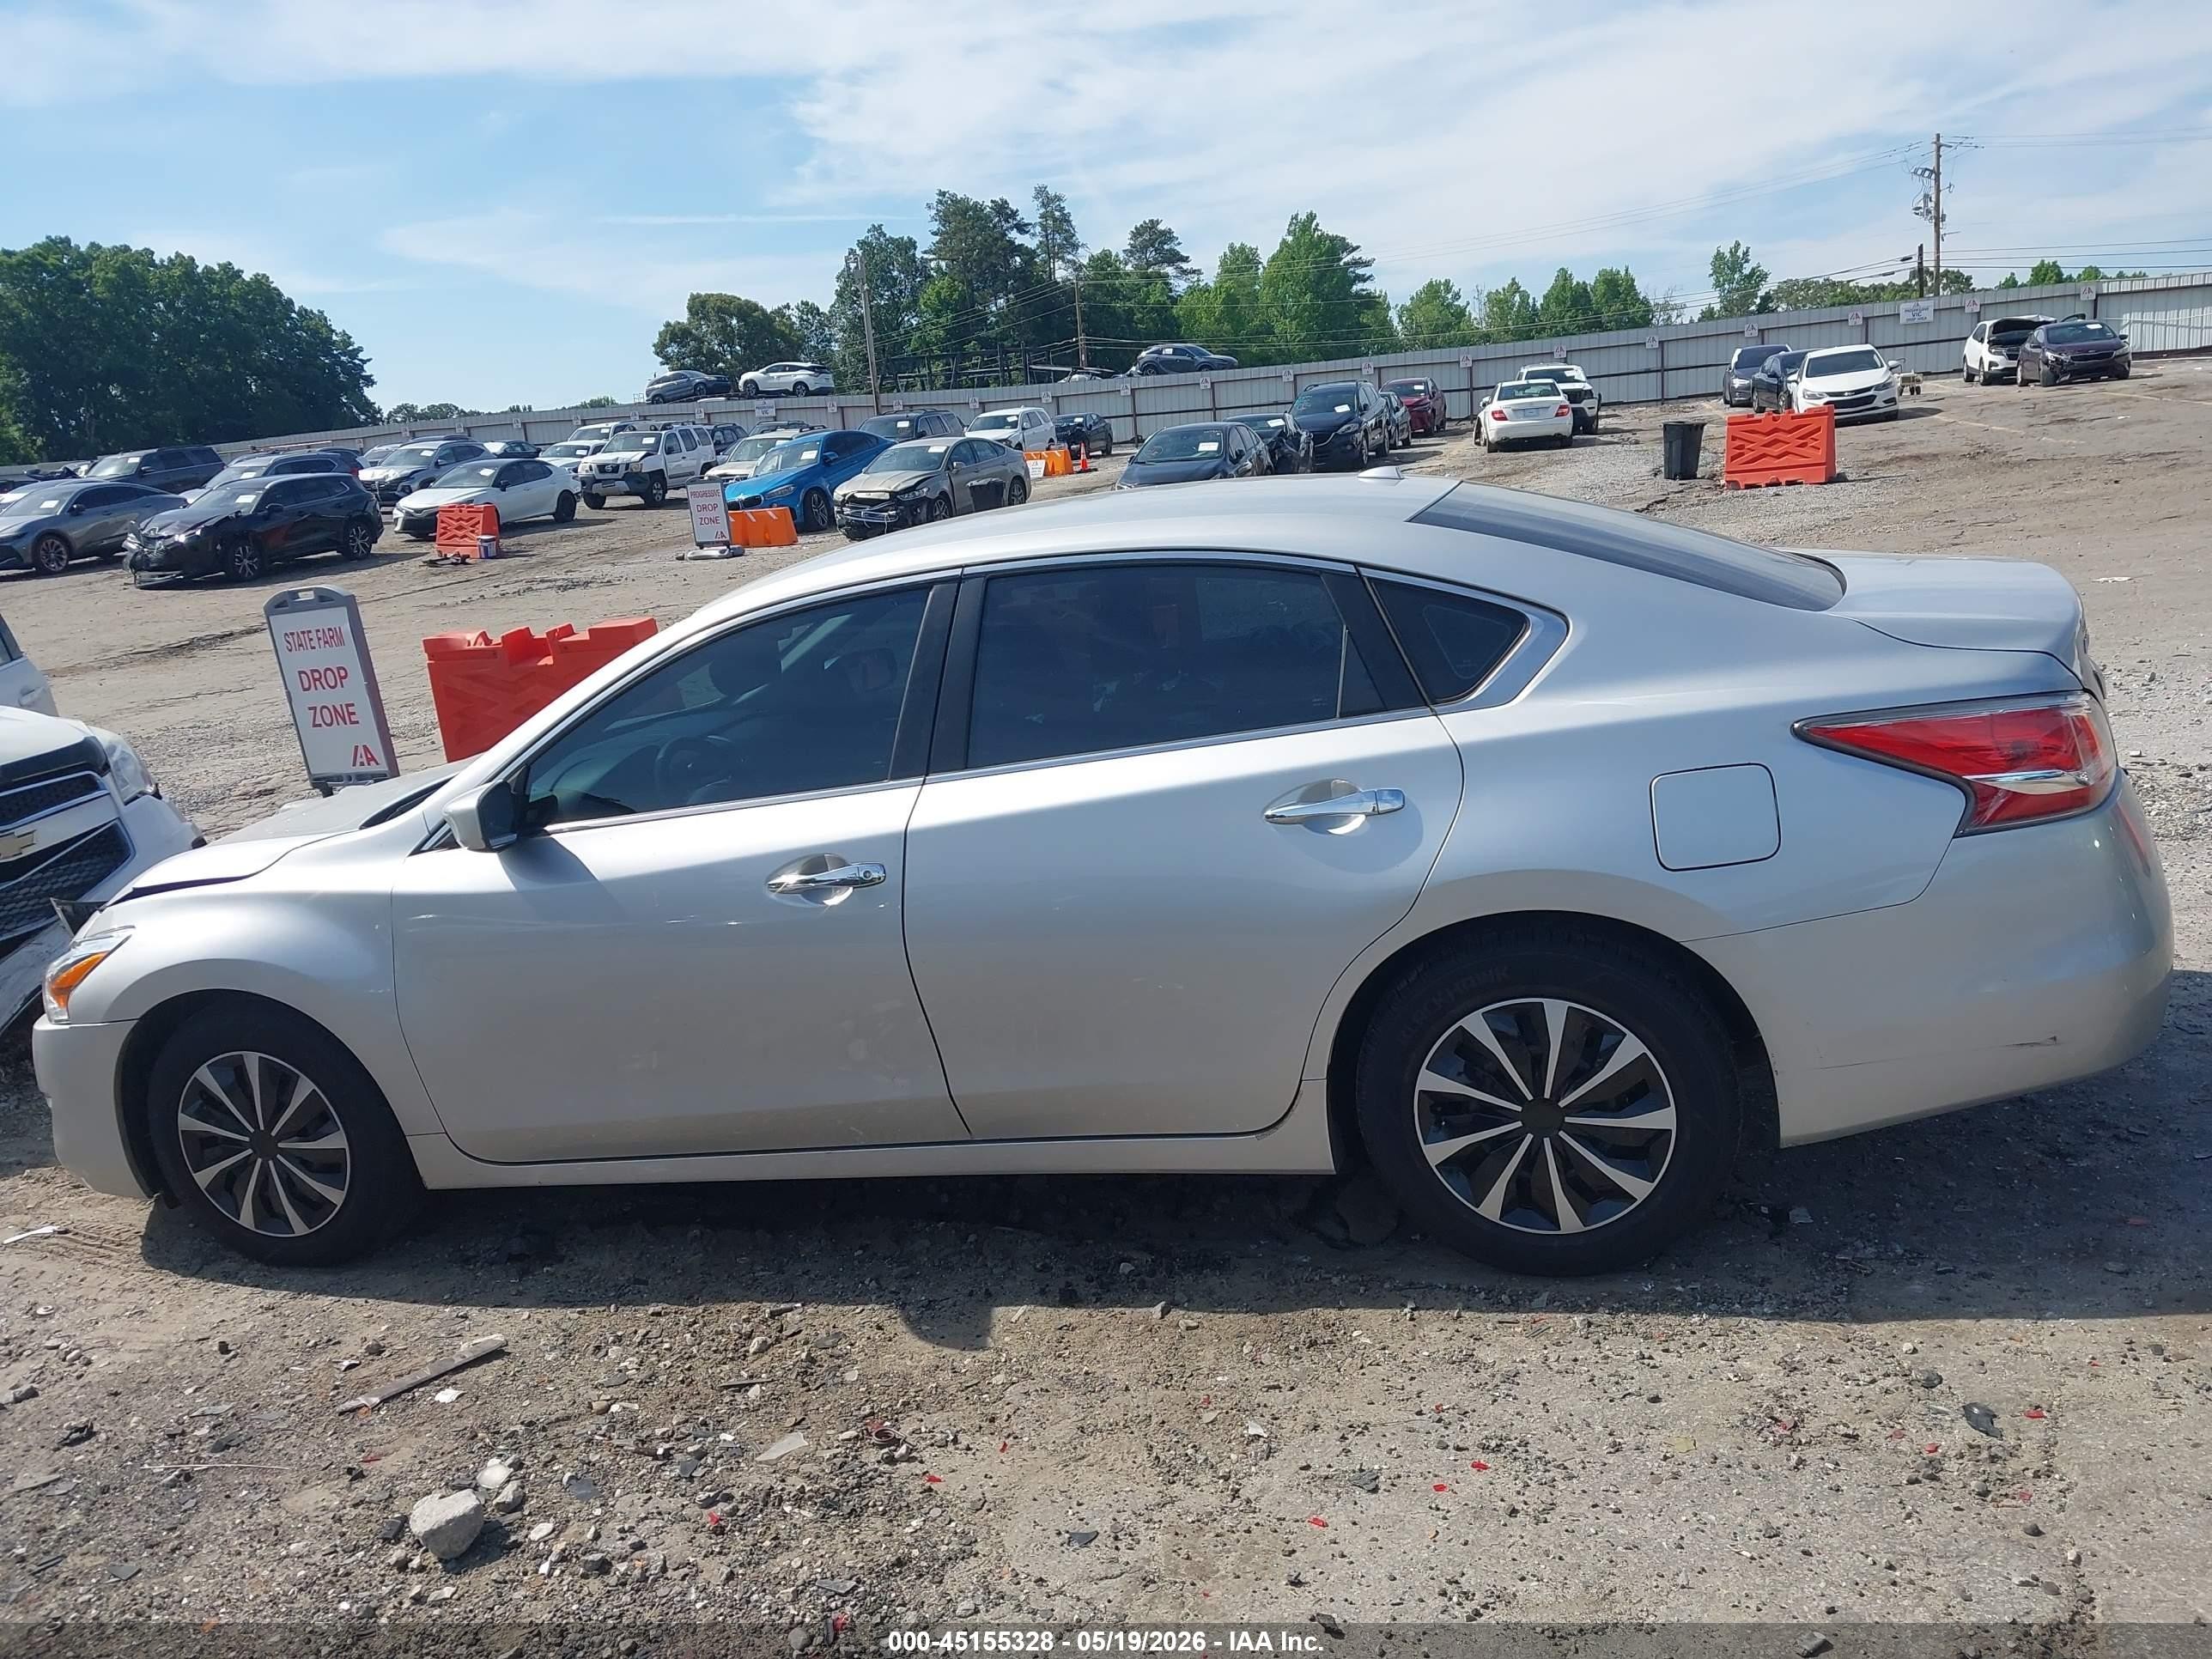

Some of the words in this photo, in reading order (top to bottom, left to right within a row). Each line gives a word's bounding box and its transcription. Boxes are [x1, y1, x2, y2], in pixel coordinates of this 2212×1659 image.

[696, 503, 719, 513] DROP
[699, 516, 721, 526] ZONE
[283, 629, 316, 653] STATE
[315, 626, 345, 648] FARM
[297, 665, 349, 692] DROP
[307, 702, 360, 728] ZONE
